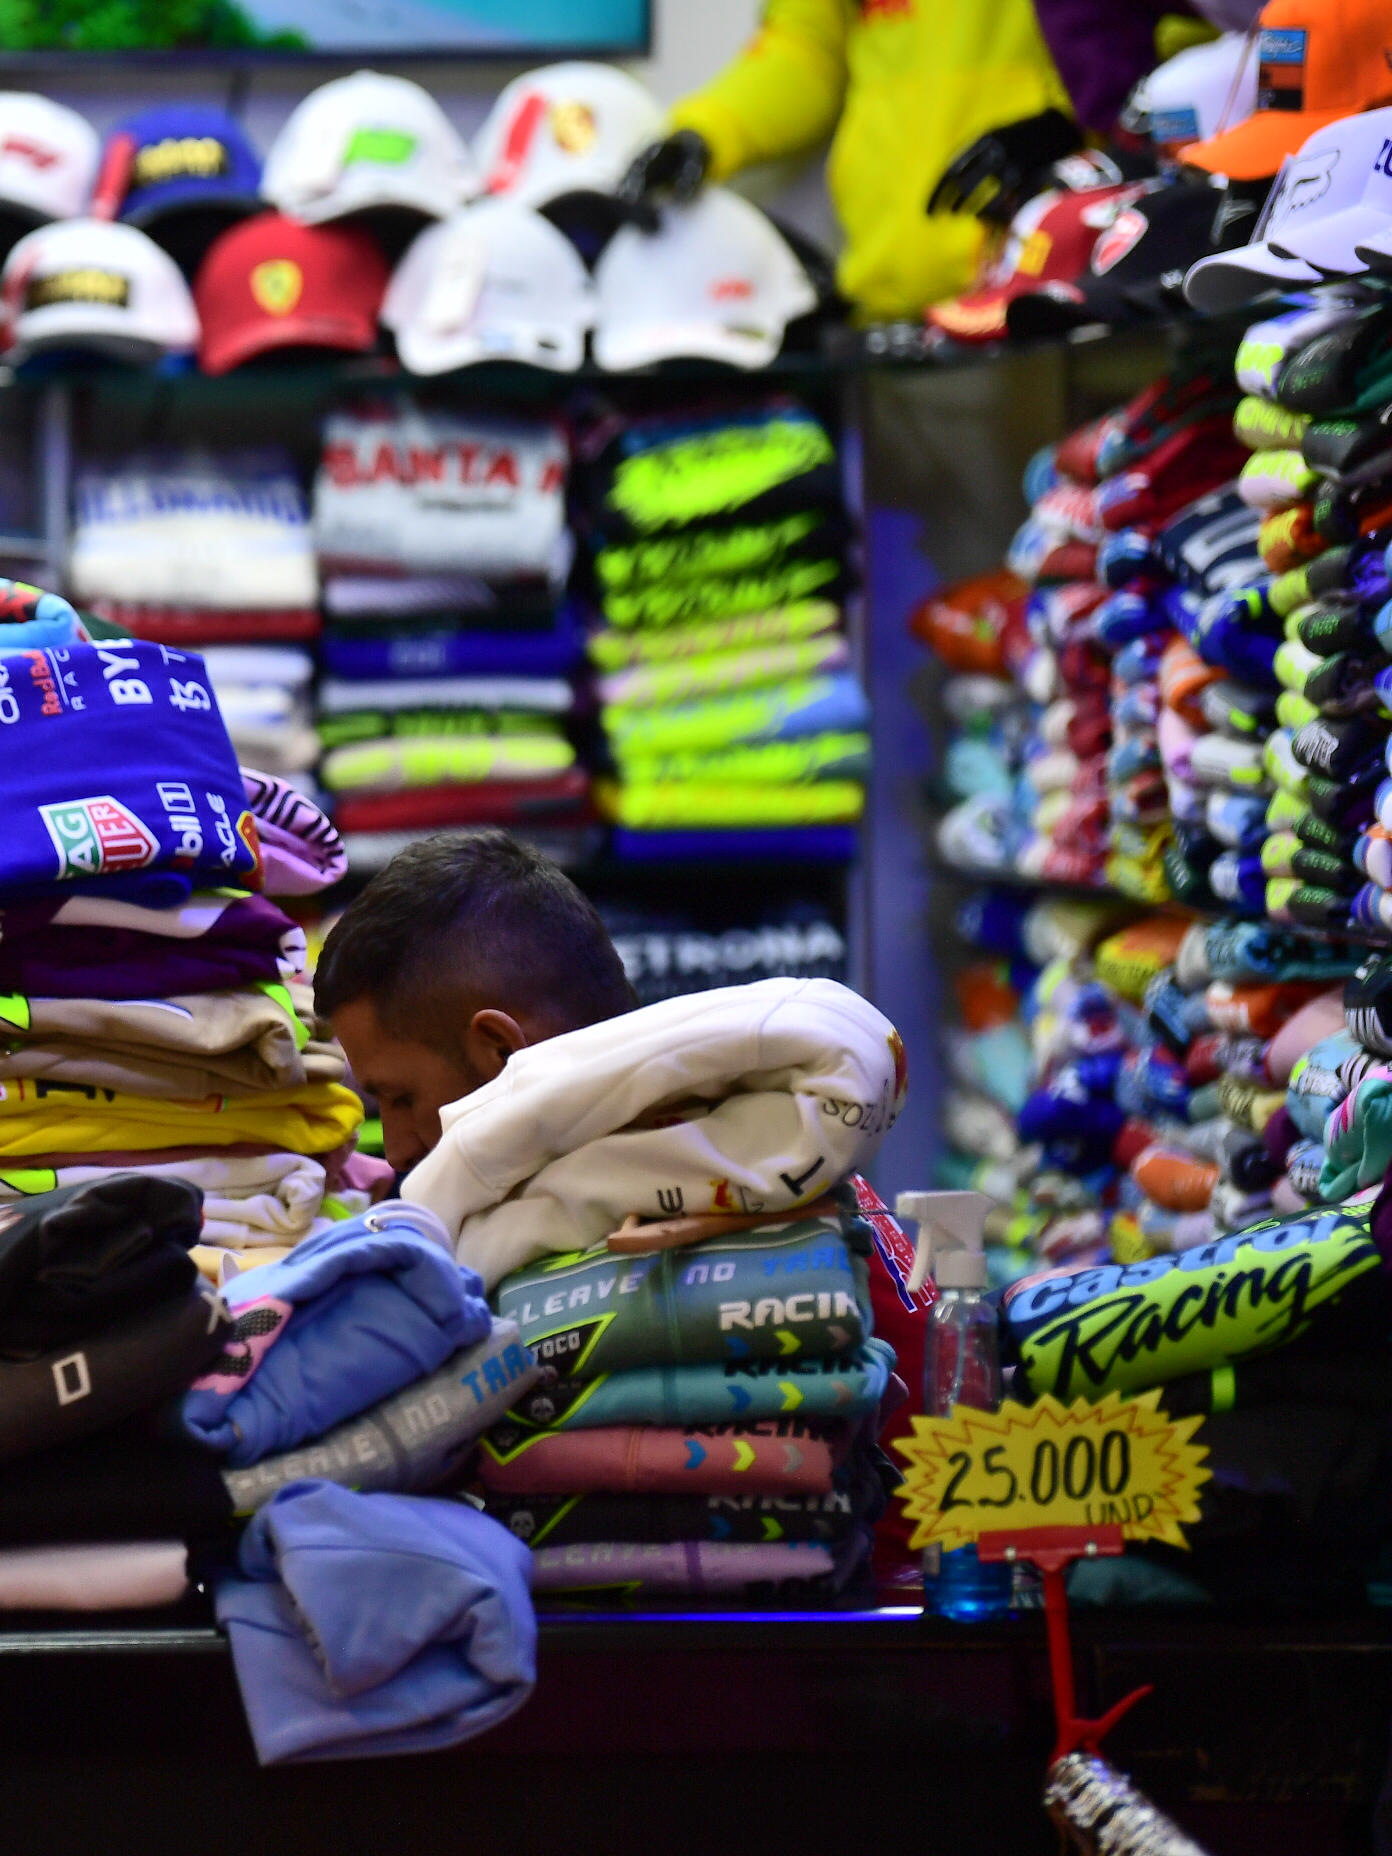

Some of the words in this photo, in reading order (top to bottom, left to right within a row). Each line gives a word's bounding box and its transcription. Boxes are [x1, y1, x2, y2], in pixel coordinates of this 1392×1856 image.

[54, 811, 98, 876] AG
[1033, 1252, 1315, 1398] Racing
[939, 1430, 1132, 1513] 25.000
